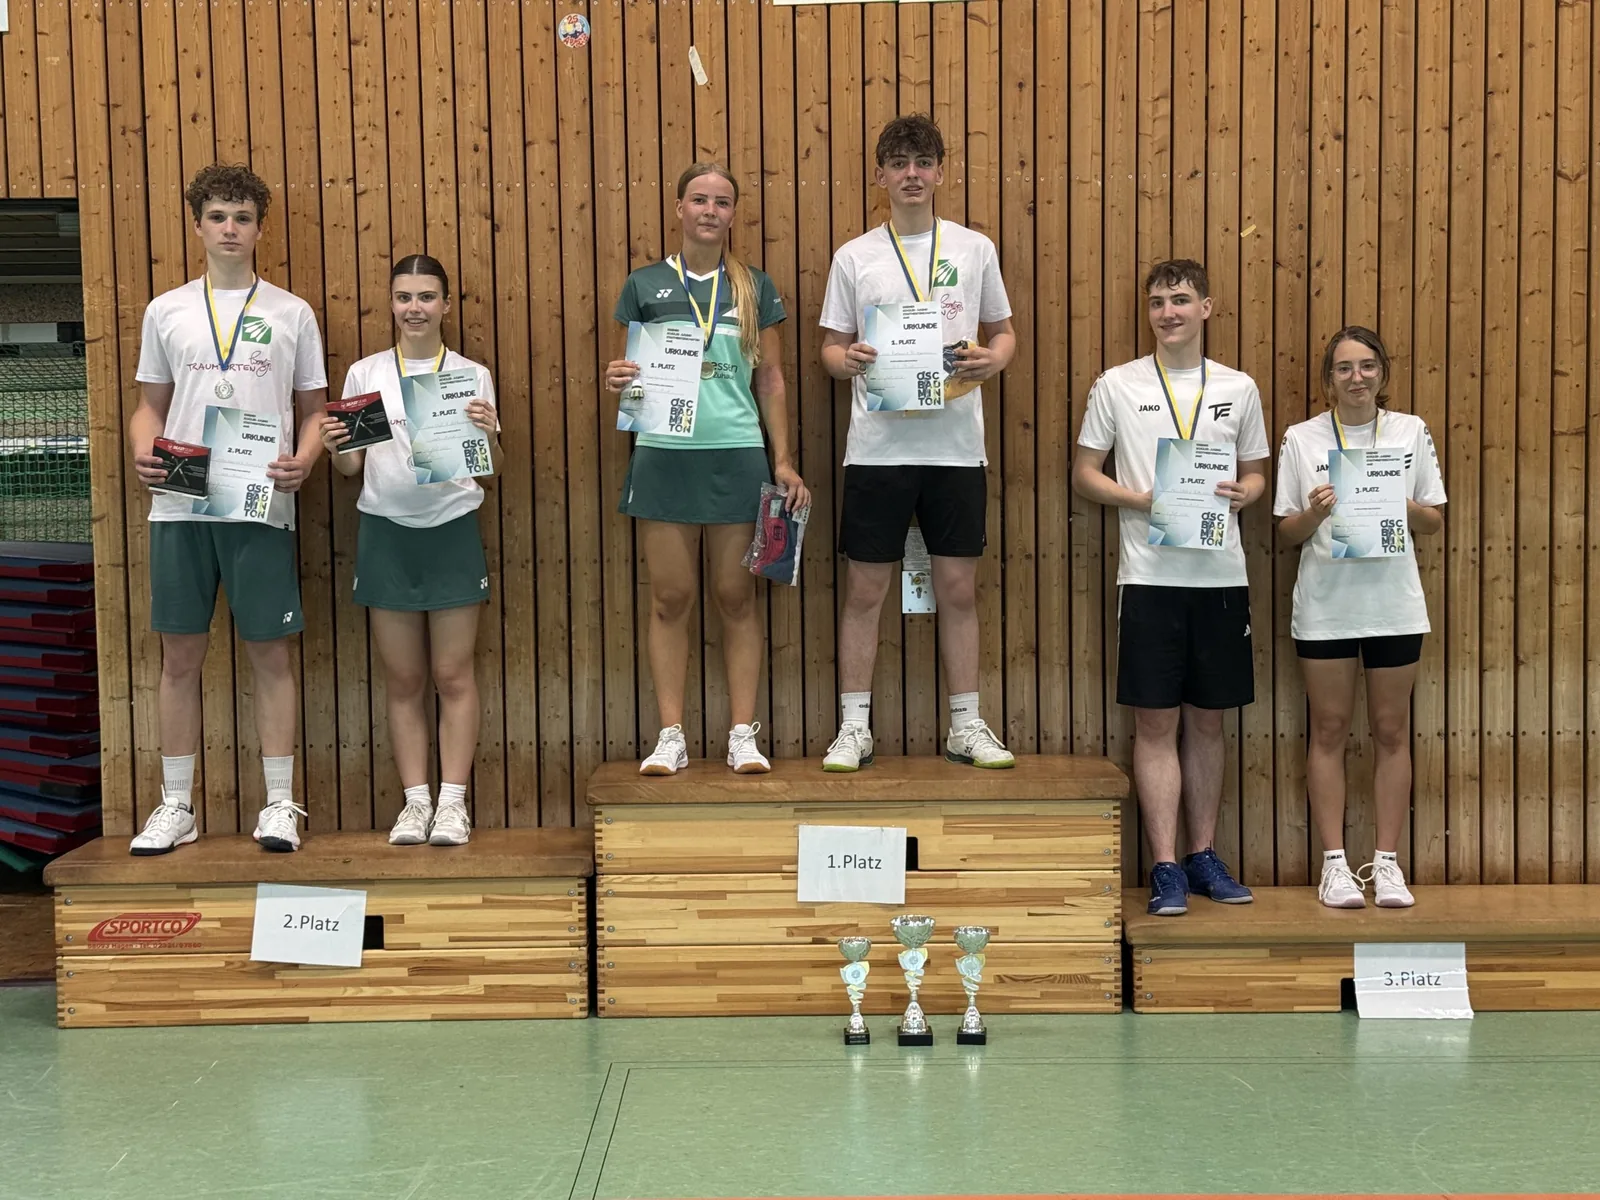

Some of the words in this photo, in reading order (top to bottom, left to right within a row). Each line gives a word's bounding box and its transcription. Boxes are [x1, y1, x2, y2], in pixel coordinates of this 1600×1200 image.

[665, 348, 699, 357] URKUNDE
[186, 363, 256, 372] TRAUMRTEN
[442, 390, 476, 400] URKUNDE
[242, 433, 275, 443] URKUNDE
[1194, 463, 1229, 471] URKUNDE
[828, 854, 882, 869] 1.Platz
[104, 920, 183, 934] SPORTCO
[283, 914, 339, 931] 2.Platz
[1384, 970, 1441, 986] 3.Platz
